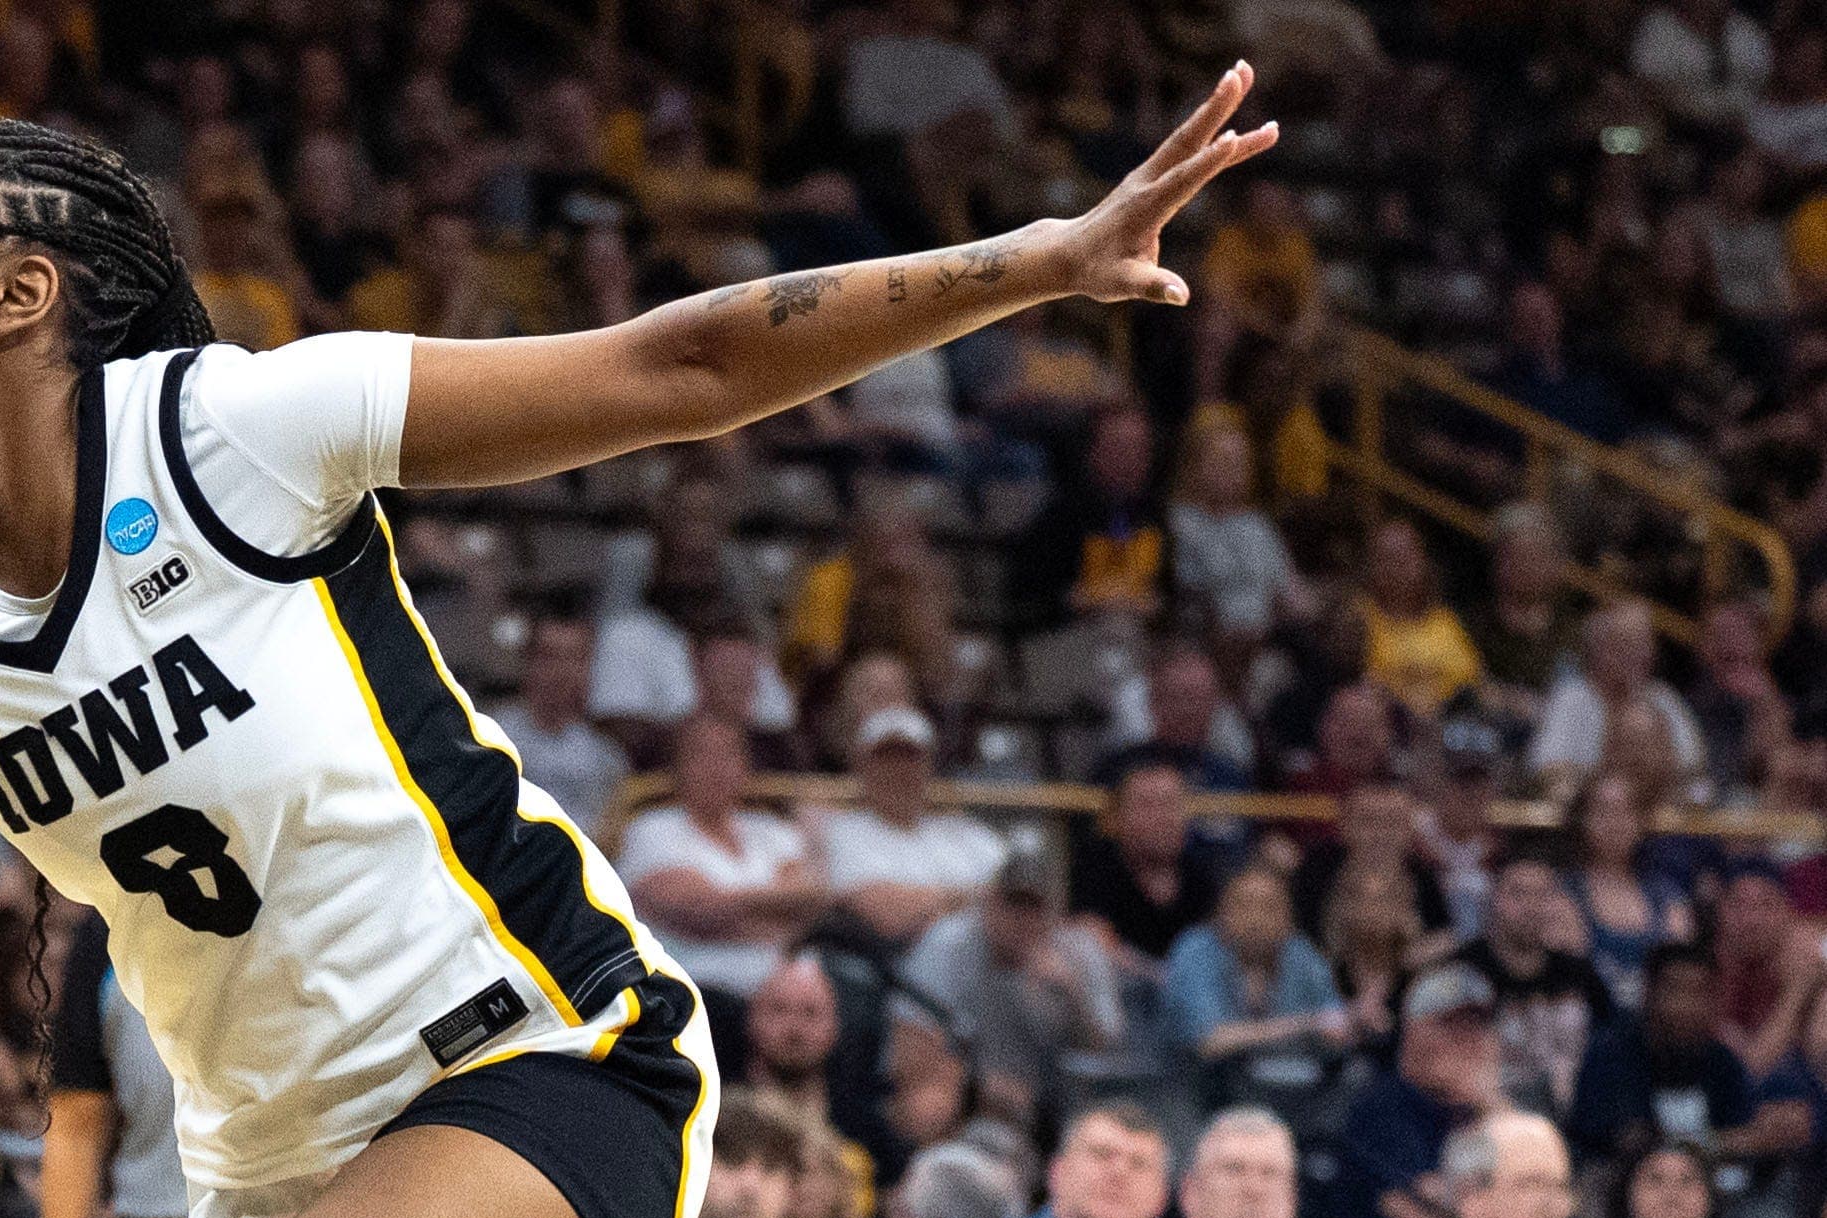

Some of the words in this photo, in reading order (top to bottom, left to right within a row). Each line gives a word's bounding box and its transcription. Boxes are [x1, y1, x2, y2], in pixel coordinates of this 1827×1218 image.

[114, 513, 155, 544] NCAA
[100, 803, 262, 938] 8
[488, 997, 510, 1019] M
